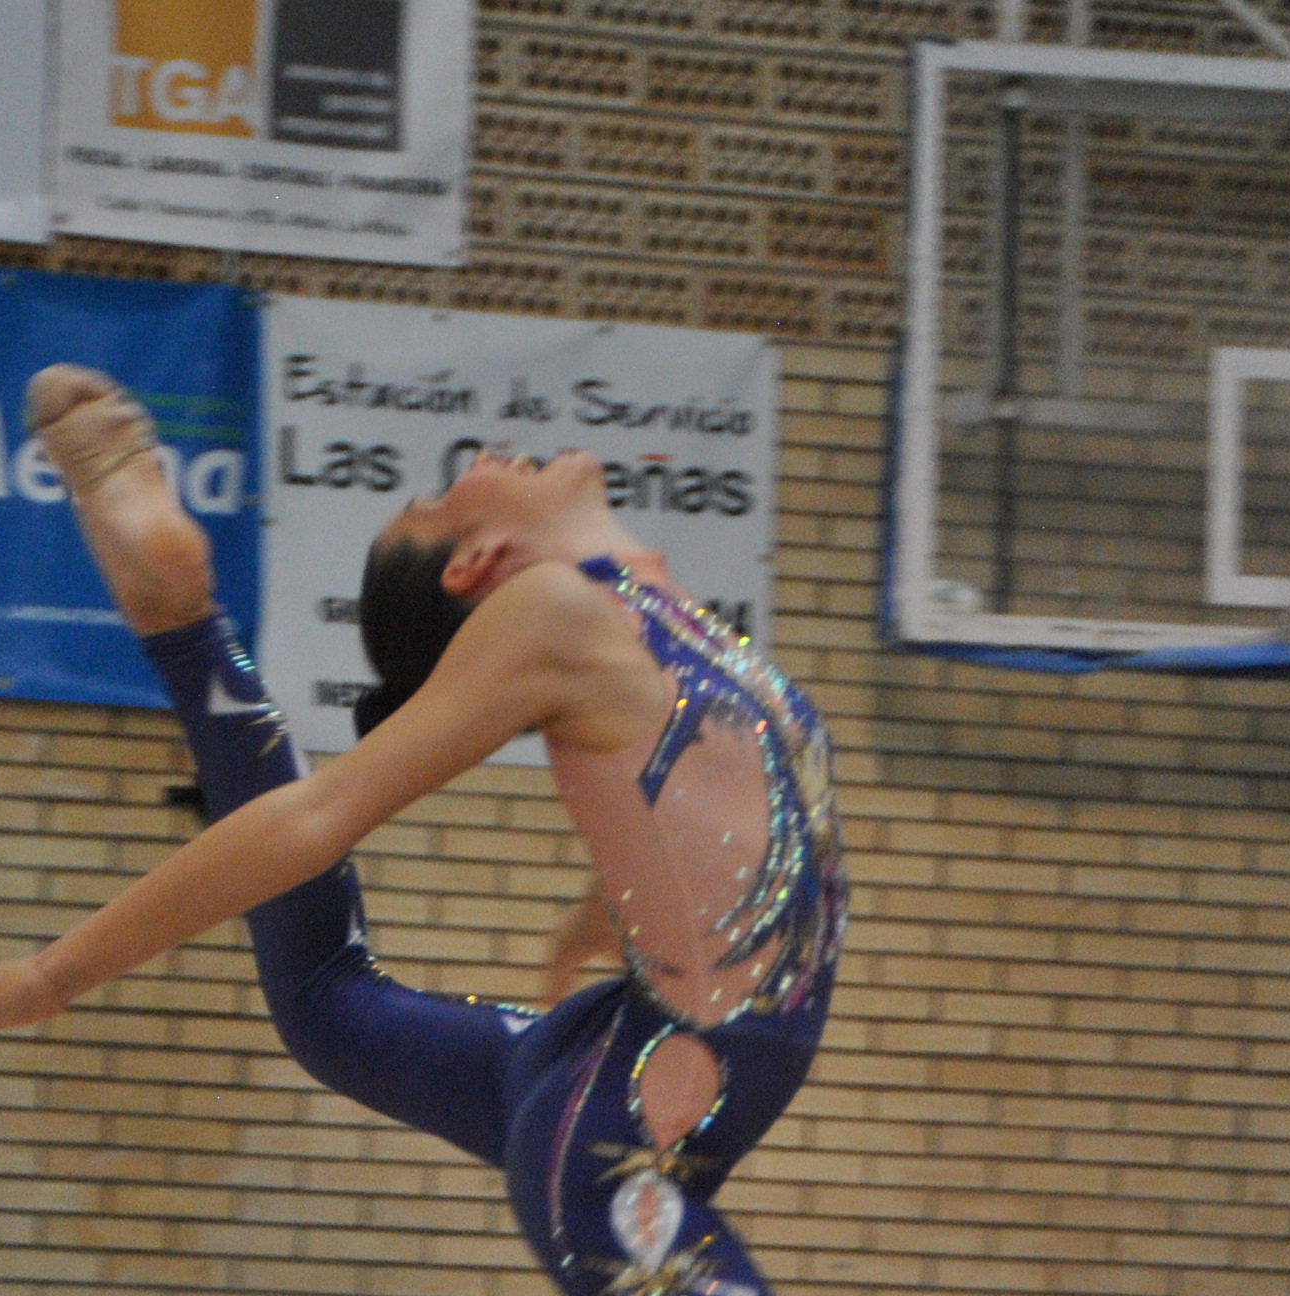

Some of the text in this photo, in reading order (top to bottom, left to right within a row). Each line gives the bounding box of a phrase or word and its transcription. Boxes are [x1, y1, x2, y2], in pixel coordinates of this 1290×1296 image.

[109, 54, 261, 127] TGA
[501, 376, 554, 423] de
[571, 376, 757, 438] Servicio
[277, 425, 405, 495] Las
